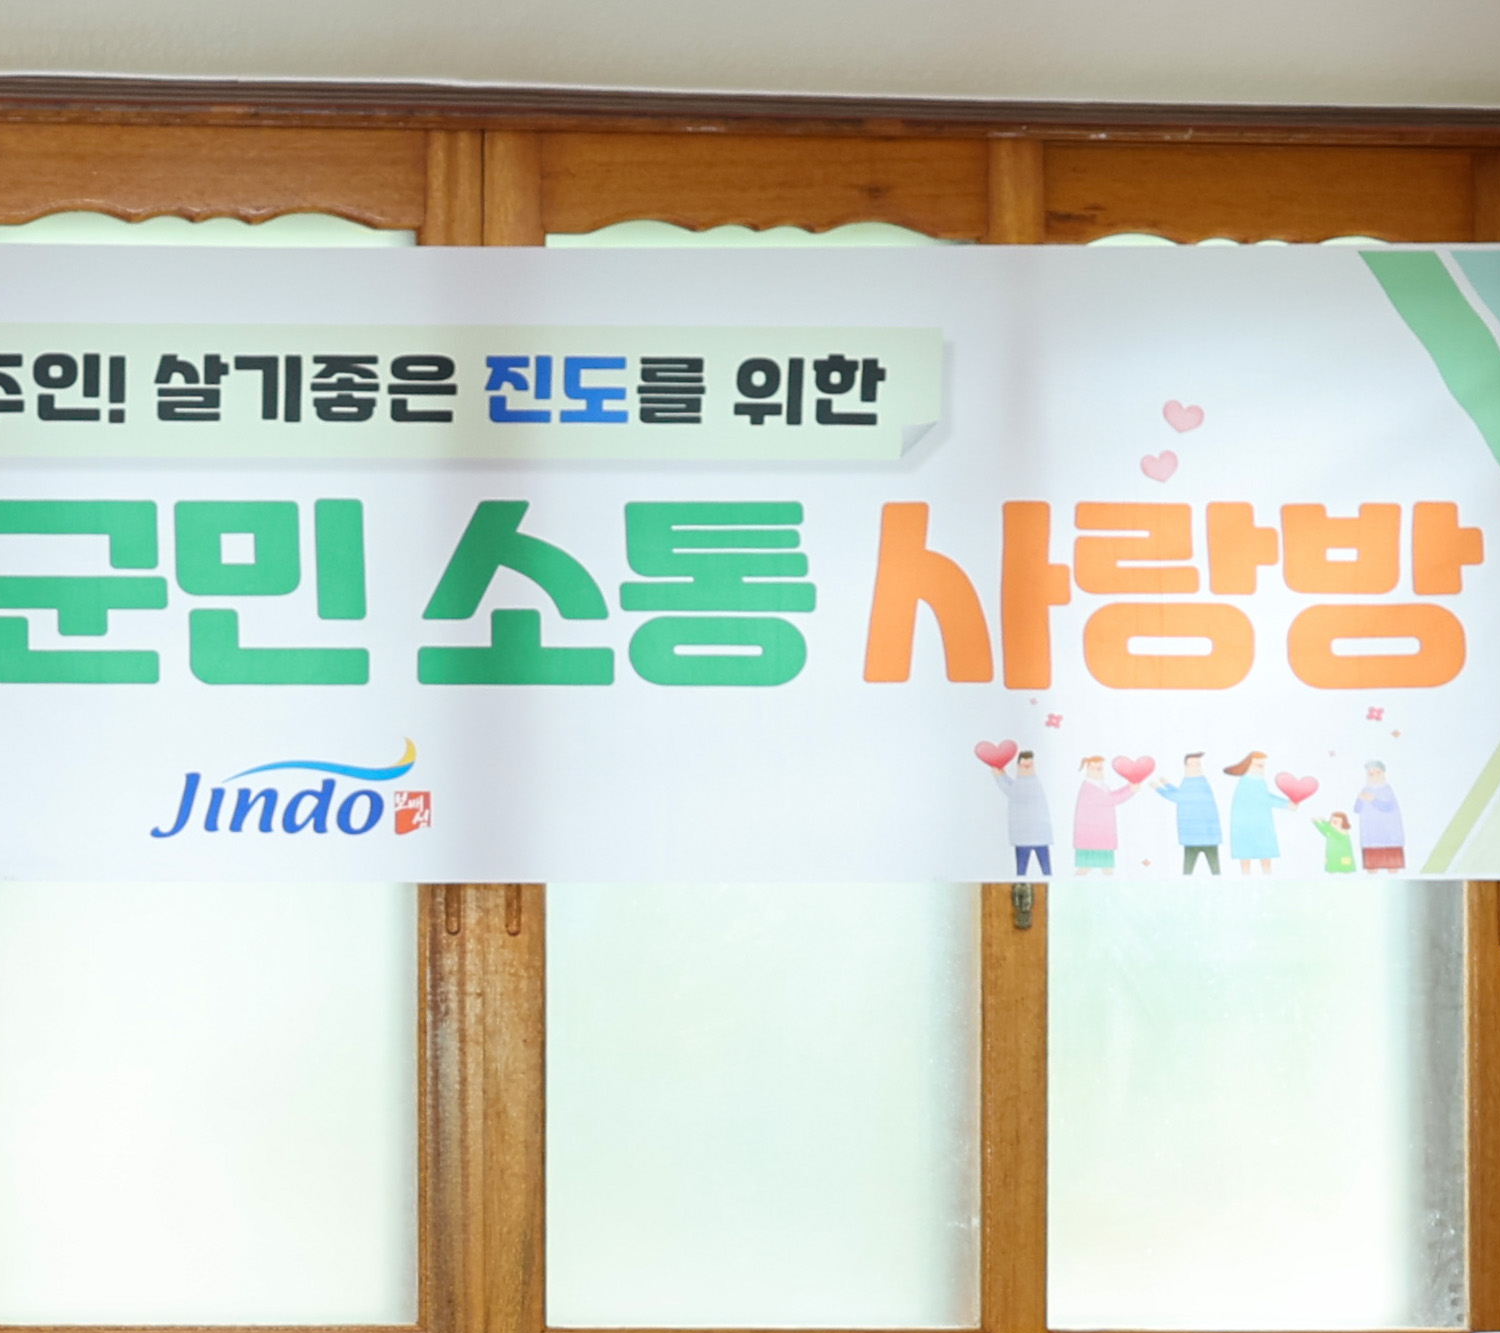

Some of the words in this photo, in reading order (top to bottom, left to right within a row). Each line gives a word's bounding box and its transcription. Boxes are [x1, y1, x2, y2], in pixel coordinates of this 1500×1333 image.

[155, 354, 458, 423] 살기좋은
[485, 356, 706, 424] 진도를
[733, 354, 887, 426] 위한
[417, 500, 817, 688] 소통
[863, 499, 1485, 691] 사랑방
[150, 772, 385, 838] Jindo
